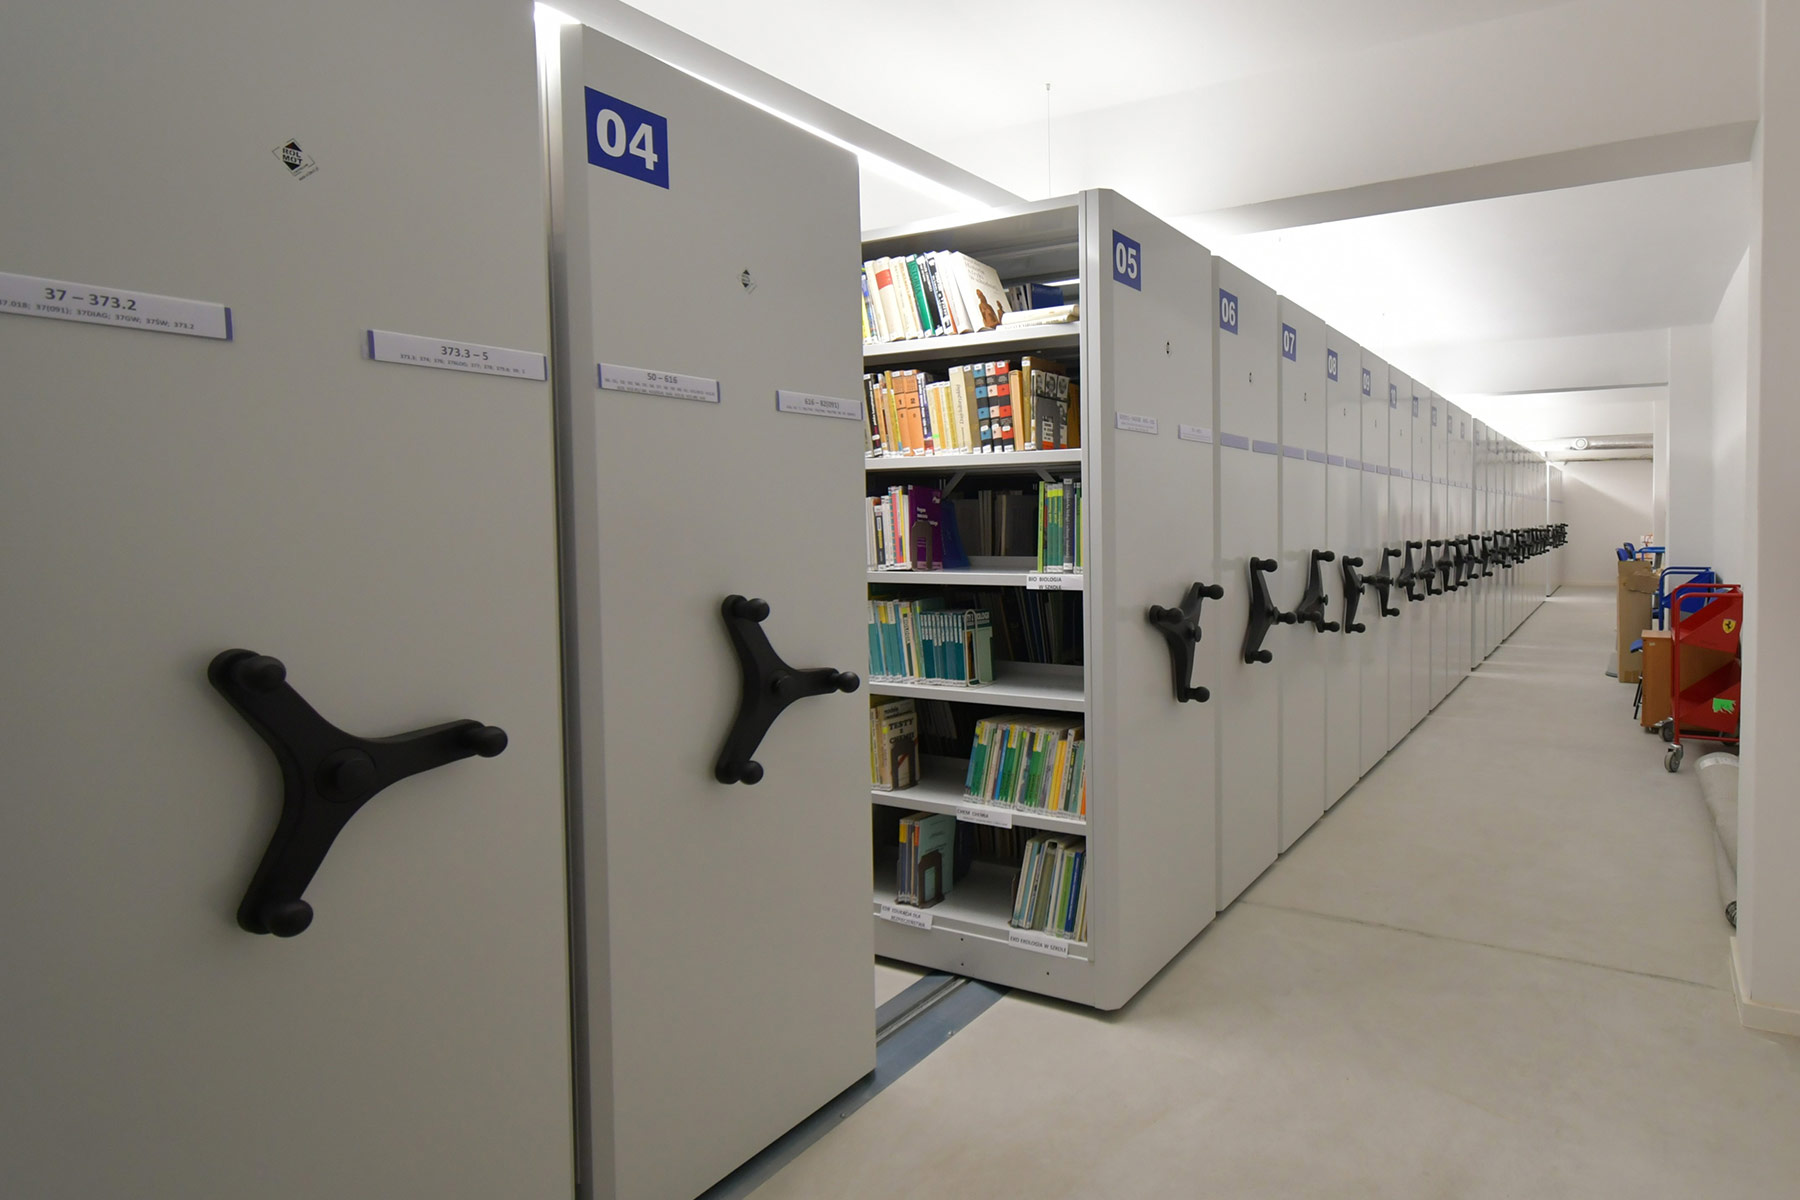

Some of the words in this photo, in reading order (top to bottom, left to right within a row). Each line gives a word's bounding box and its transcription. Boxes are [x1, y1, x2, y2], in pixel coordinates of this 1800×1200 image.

[596, 108, 659, 171] 04
[282, 147, 302, 158] ROL
[282, 154, 303, 165] MOT
[1115, 241, 1138, 280] 05
[44, 287, 67, 301] 37
[88, 293, 137, 311] 373.2
[1221, 297, 1236, 327] 06
[174, 322, 195, 330] 373.2
[1283, 330, 1296, 355] 07
[441, 345, 471, 359] 373.3
[482, 351, 489, 361] 5
[1328, 354, 1337, 376] 08
[1362, 372, 1370, 392] 09
[888, 718, 915, 731] TESTY
[1020, 938, 1043, 948] EKOLOGIA
